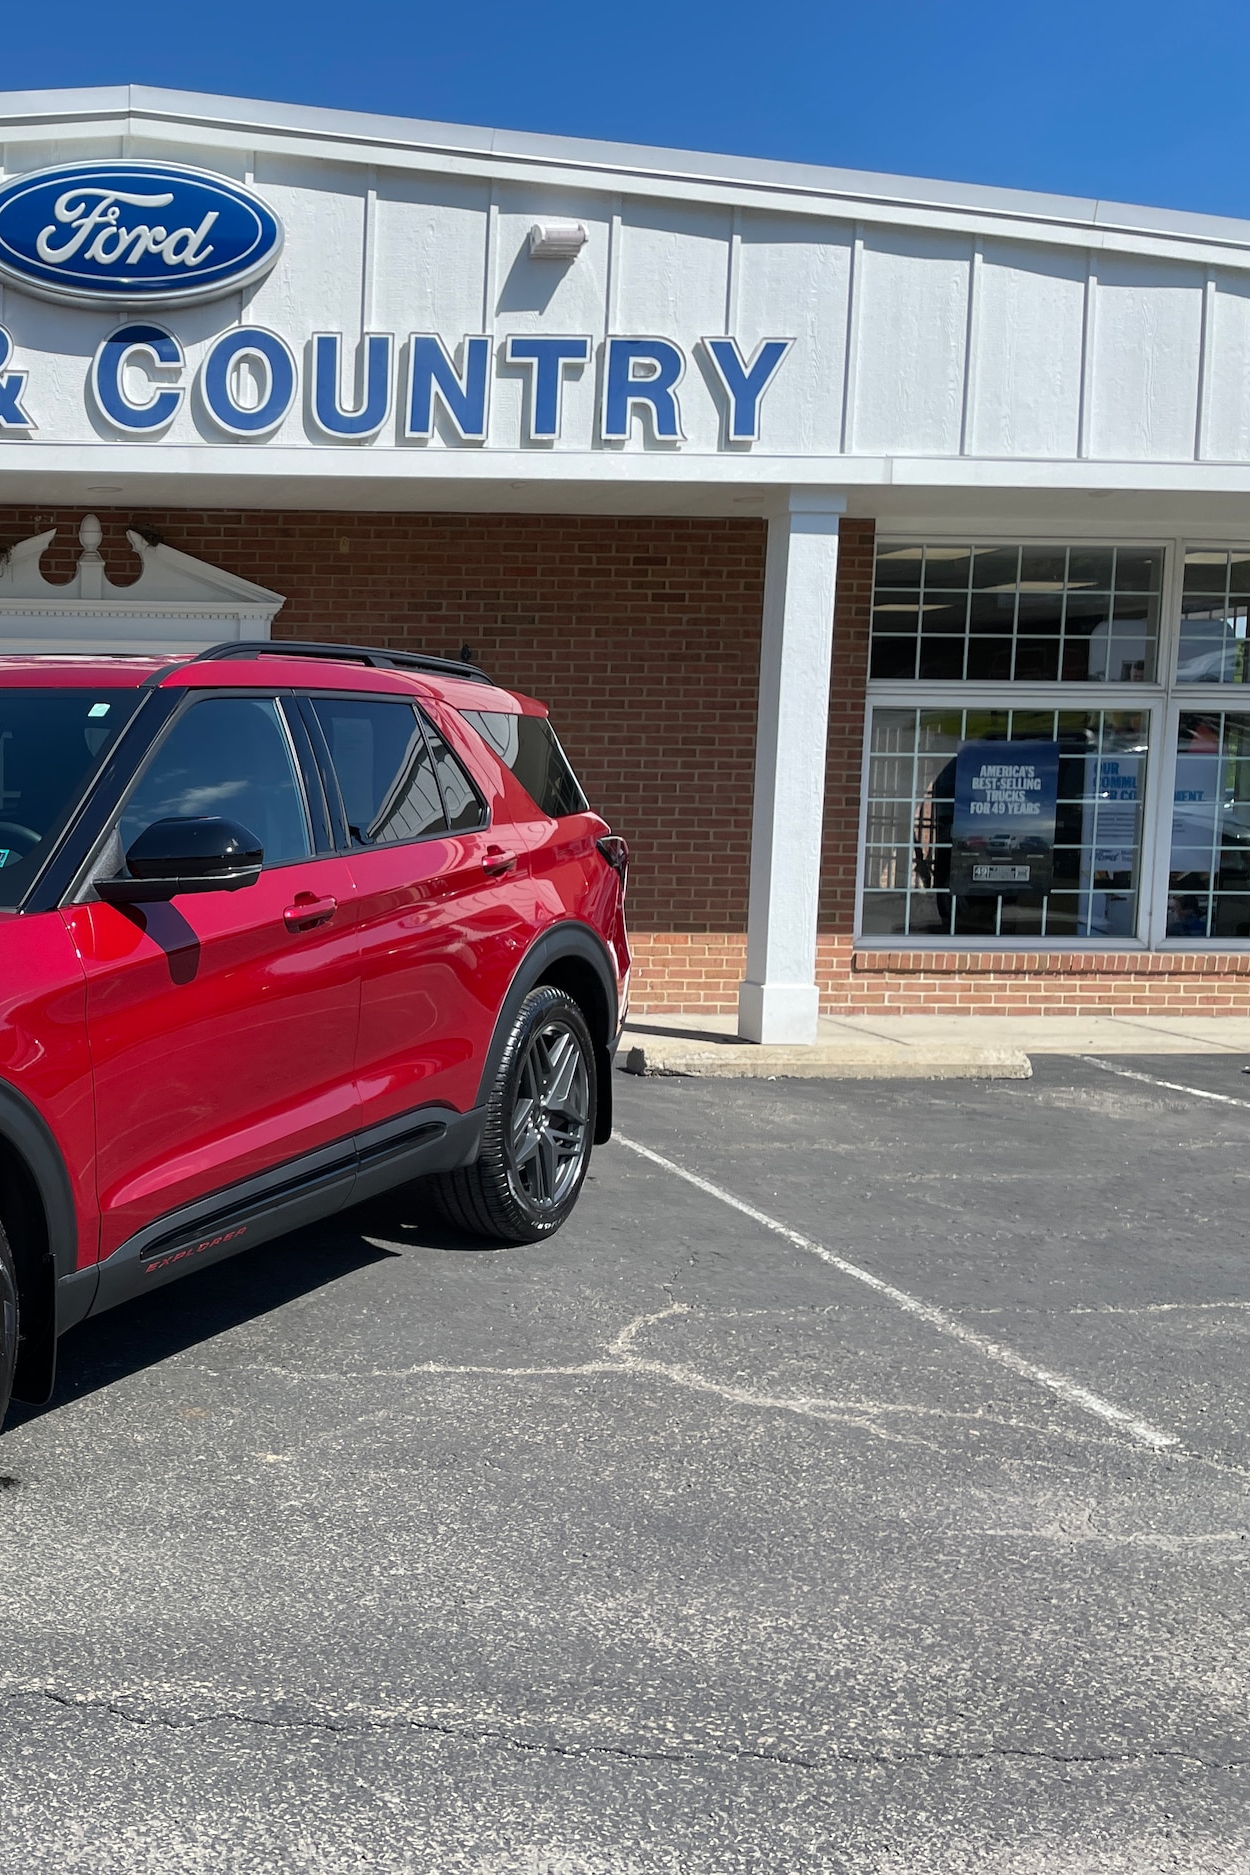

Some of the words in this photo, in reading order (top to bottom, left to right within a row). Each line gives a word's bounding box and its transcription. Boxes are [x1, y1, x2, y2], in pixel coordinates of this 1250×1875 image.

[38, 188, 220, 267] Ford
[92, 320, 796, 445] COUNTRY
[979, 765, 1035, 778] AMERICA'S
[972, 778, 1041, 790] BEST-SELLING
[985, 789, 1026, 802] TRUCKS
[970, 802, 990, 814] FOR
[992, 802, 1006, 814] 49
[1007, 803, 1041, 815] YEARS
[145, 1226, 247, 1273] EXPLORER
